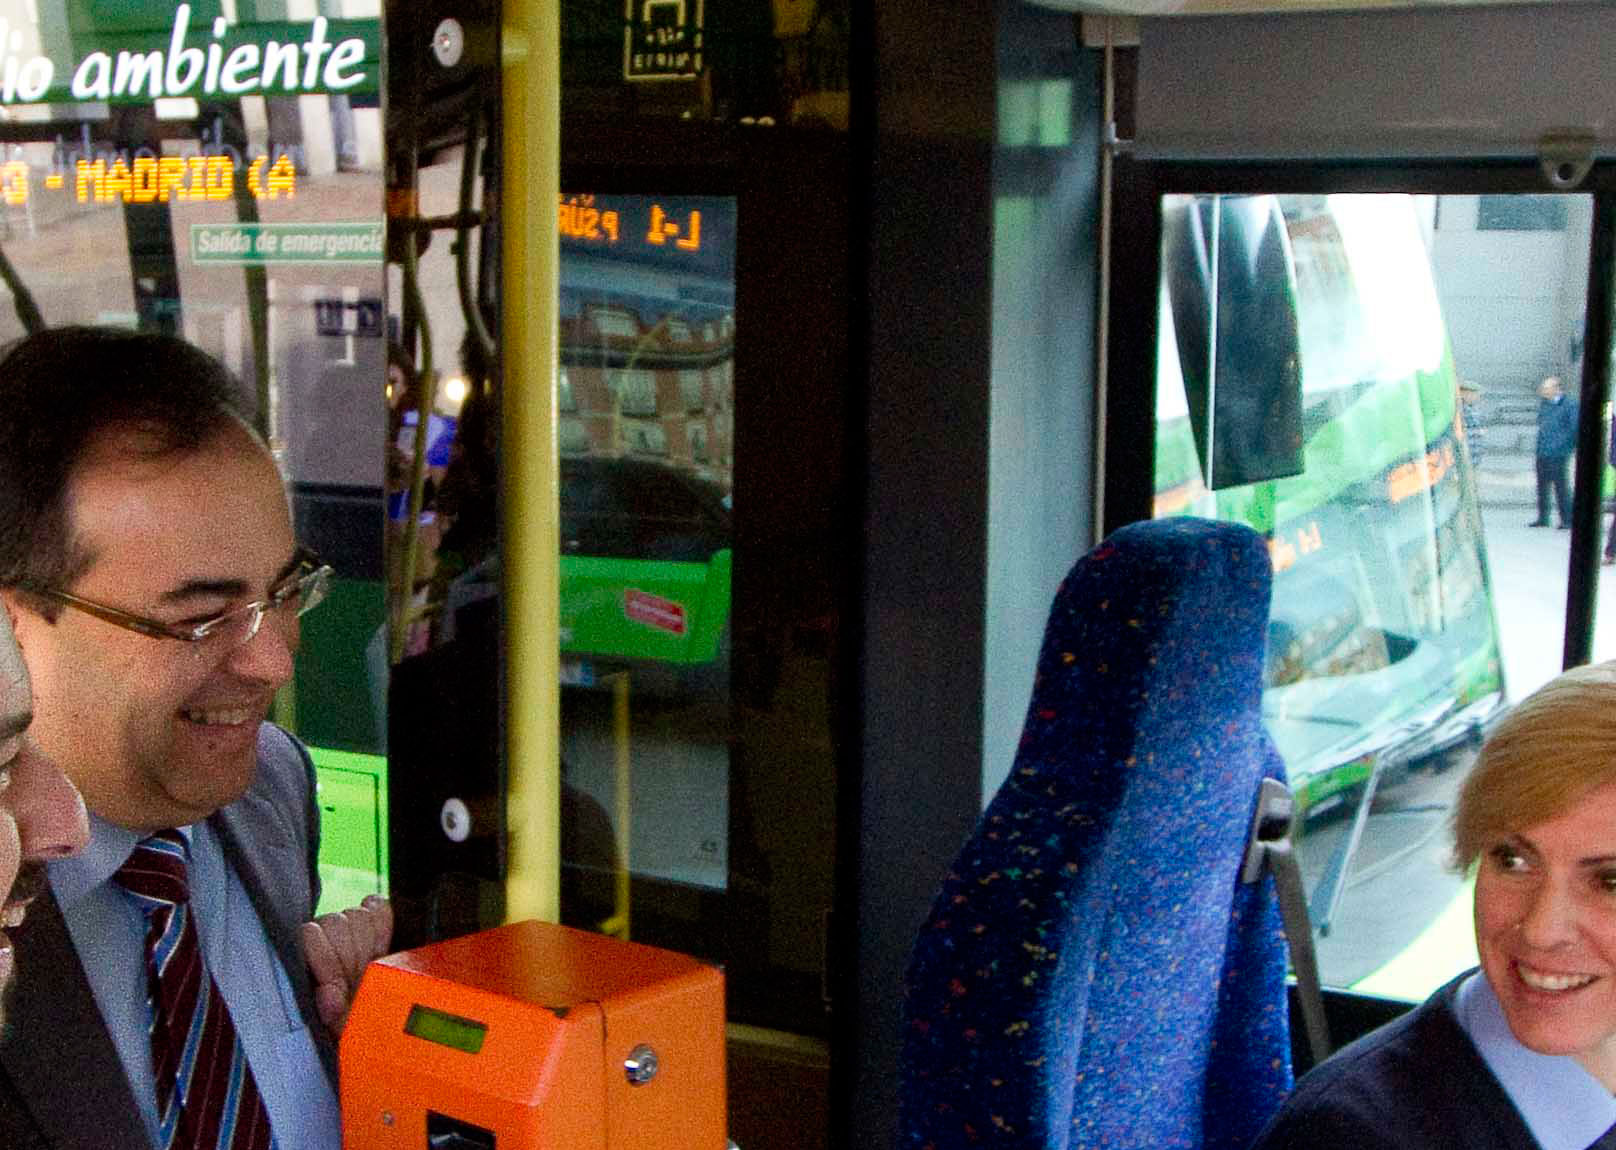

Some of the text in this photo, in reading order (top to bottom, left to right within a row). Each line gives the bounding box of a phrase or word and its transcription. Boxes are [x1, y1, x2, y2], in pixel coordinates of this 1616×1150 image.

[72, 4, 368, 99] ambiente
[76, 155, 234, 204] MADRID
[198, 230, 252, 254] Salida
[255, 231, 278, 252] de
